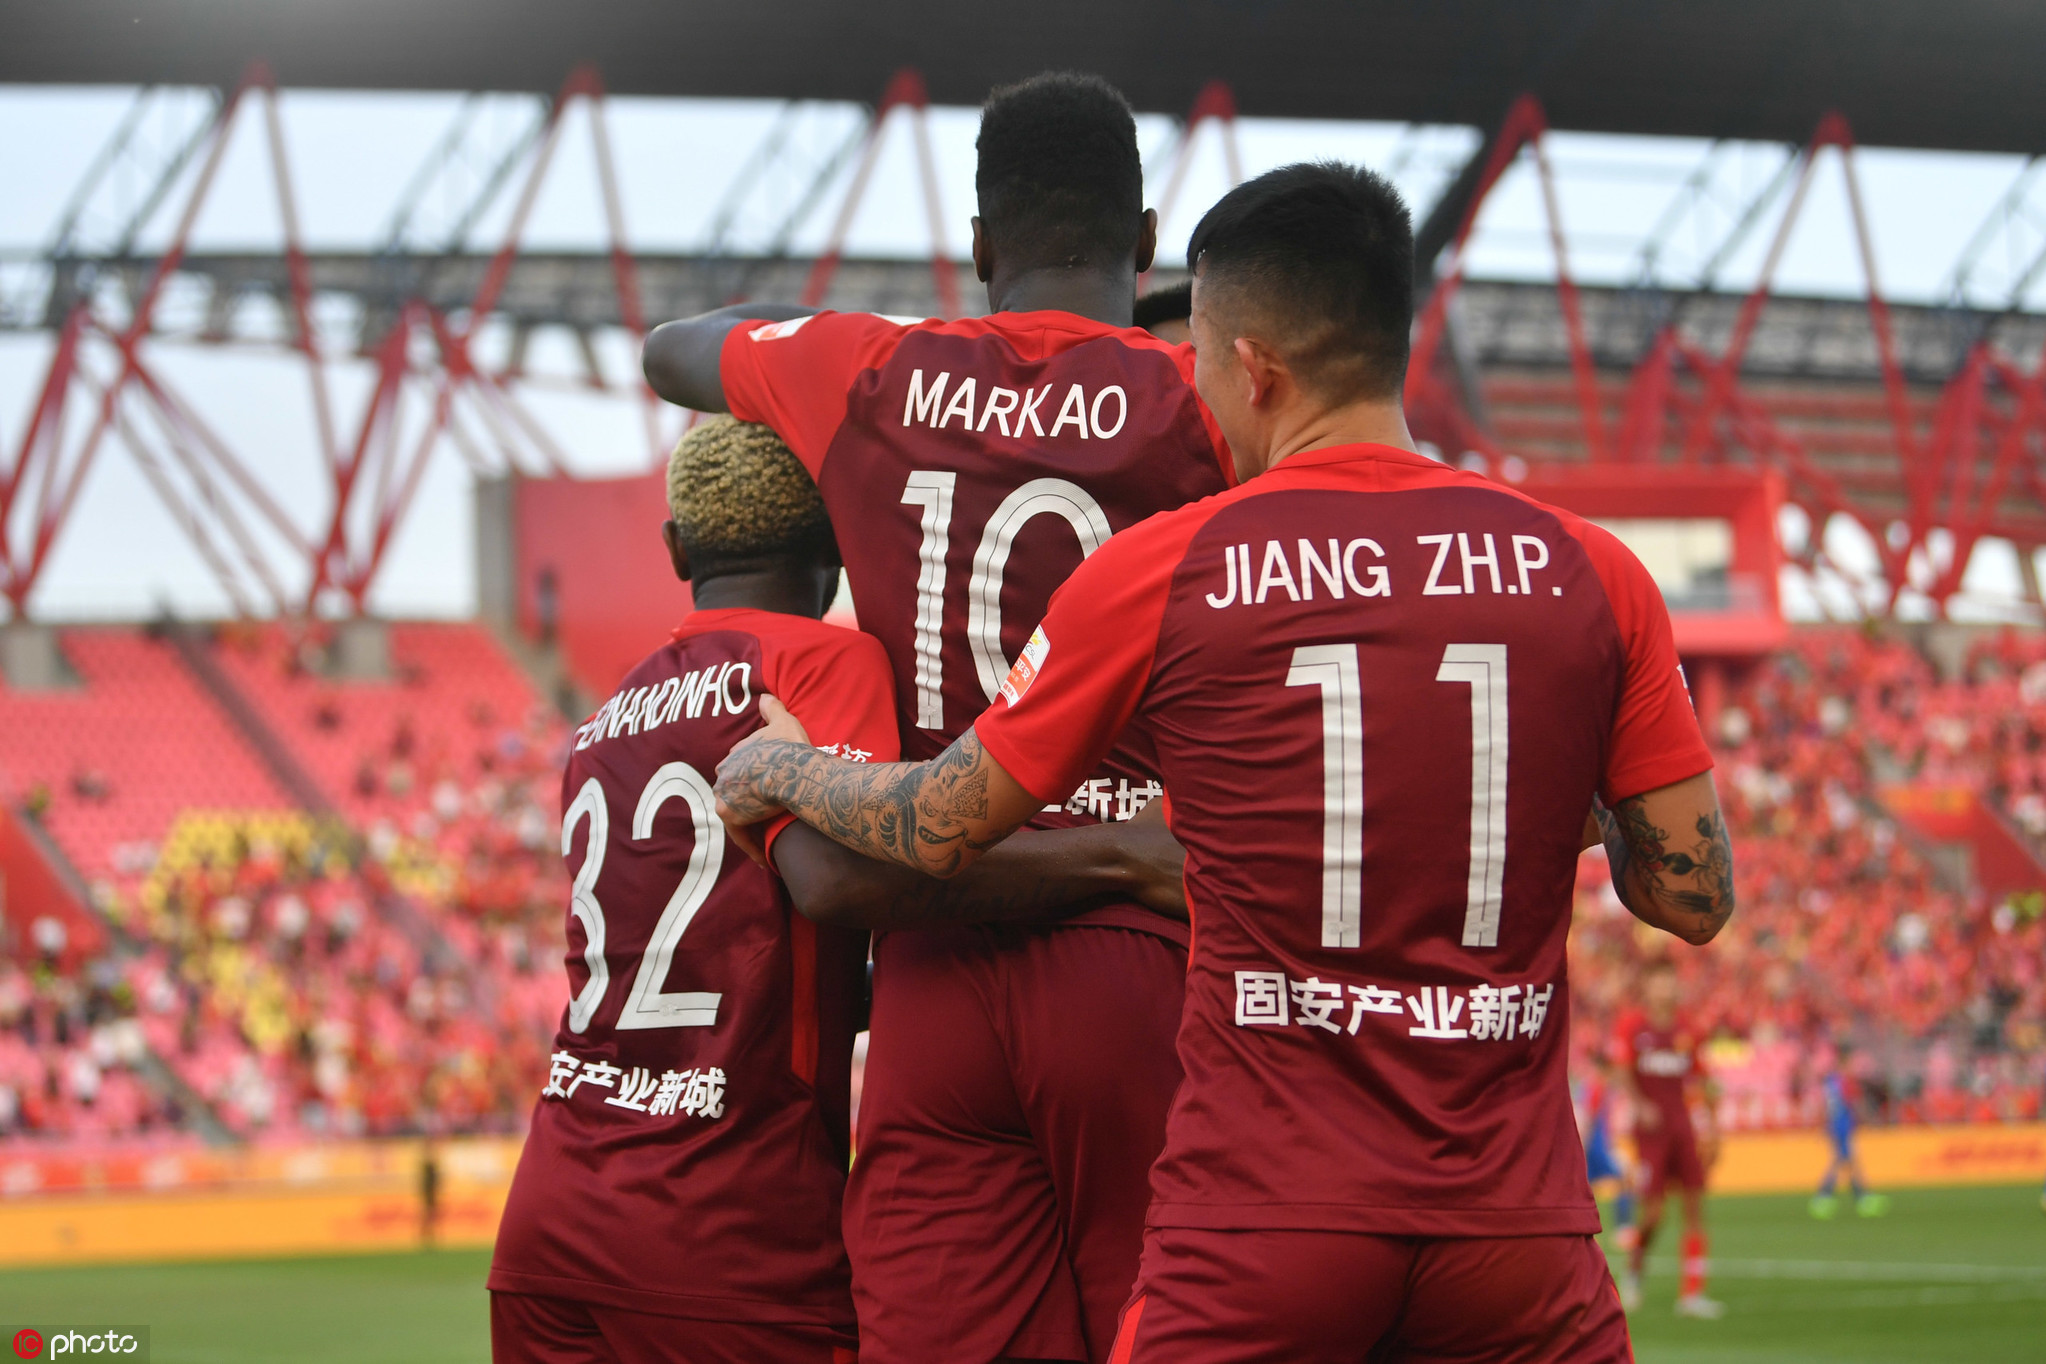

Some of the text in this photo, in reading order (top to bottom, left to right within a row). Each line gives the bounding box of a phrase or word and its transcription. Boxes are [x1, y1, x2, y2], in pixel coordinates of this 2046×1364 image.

[902, 369, 1127, 440] MARKAO
[900, 470, 1114, 731] 10
[1205, 532, 1563, 609] JIANG ZH.P.
[561, 761, 726, 1035] 32
[1285, 643, 1509, 948] 11
